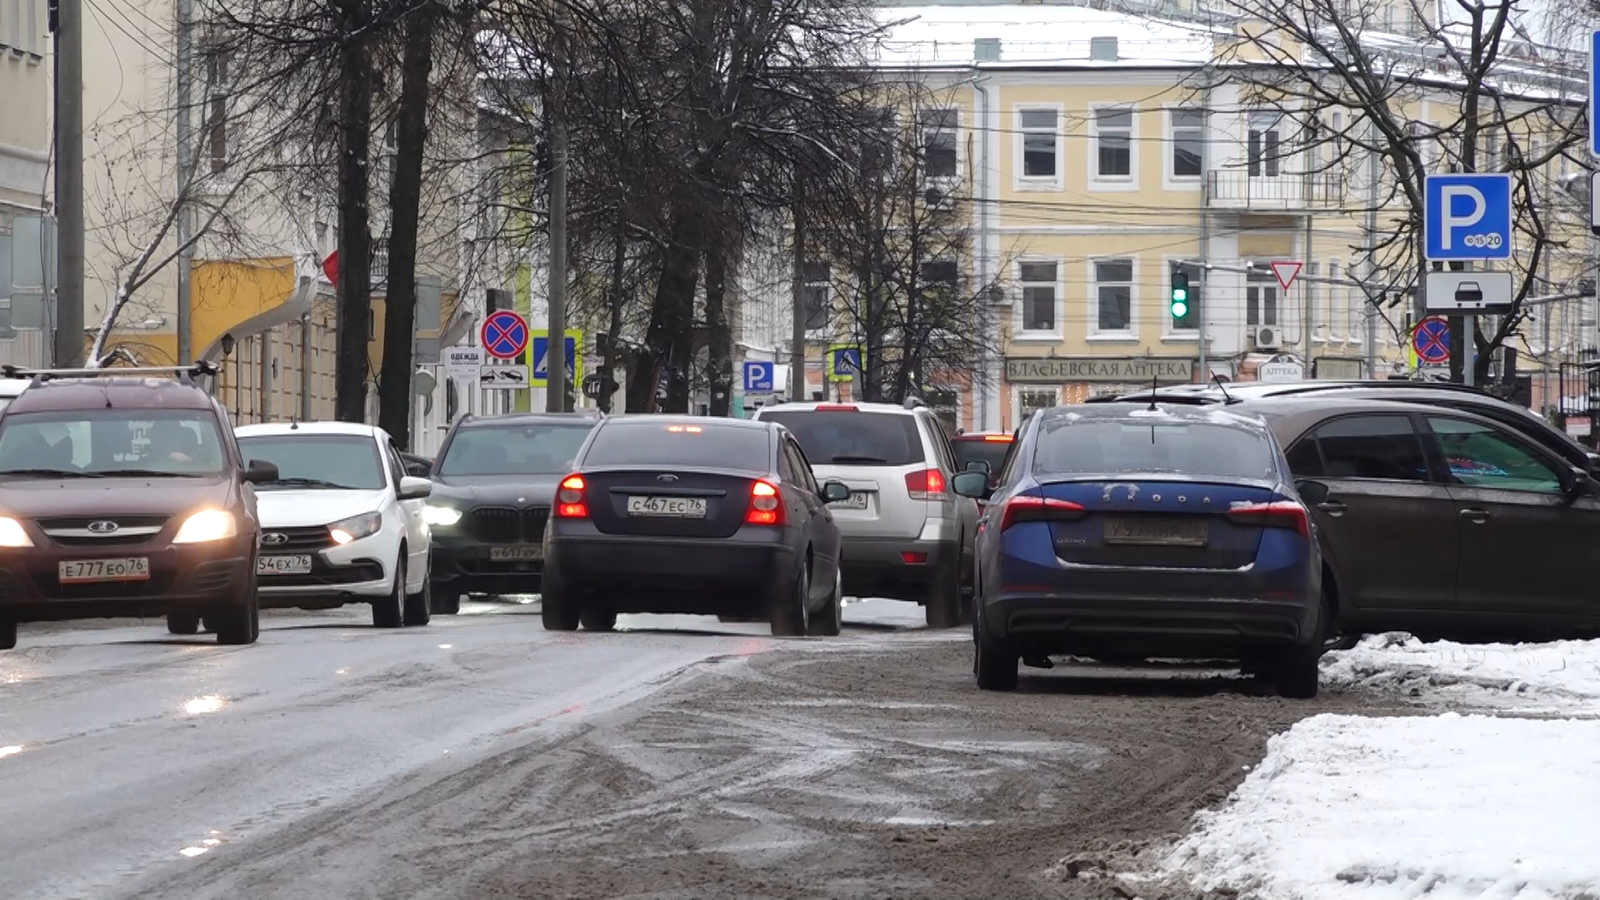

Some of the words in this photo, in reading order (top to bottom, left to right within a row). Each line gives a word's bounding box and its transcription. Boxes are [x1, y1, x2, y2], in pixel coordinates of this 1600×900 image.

[1441, 185, 1486, 250] P
[1476, 236, 1484, 246] 15
[1487, 236, 1501, 245] 20
[748, 364, 765, 388] P
[1008, 362, 1119, 377] ВЛАСЬЕВСКАЯ
[1124, 362, 1188, 376] АПТЕКА
[1266, 367, 1298, 375] АПТЕКА
[258, 557, 291, 570] 54ЕХ
